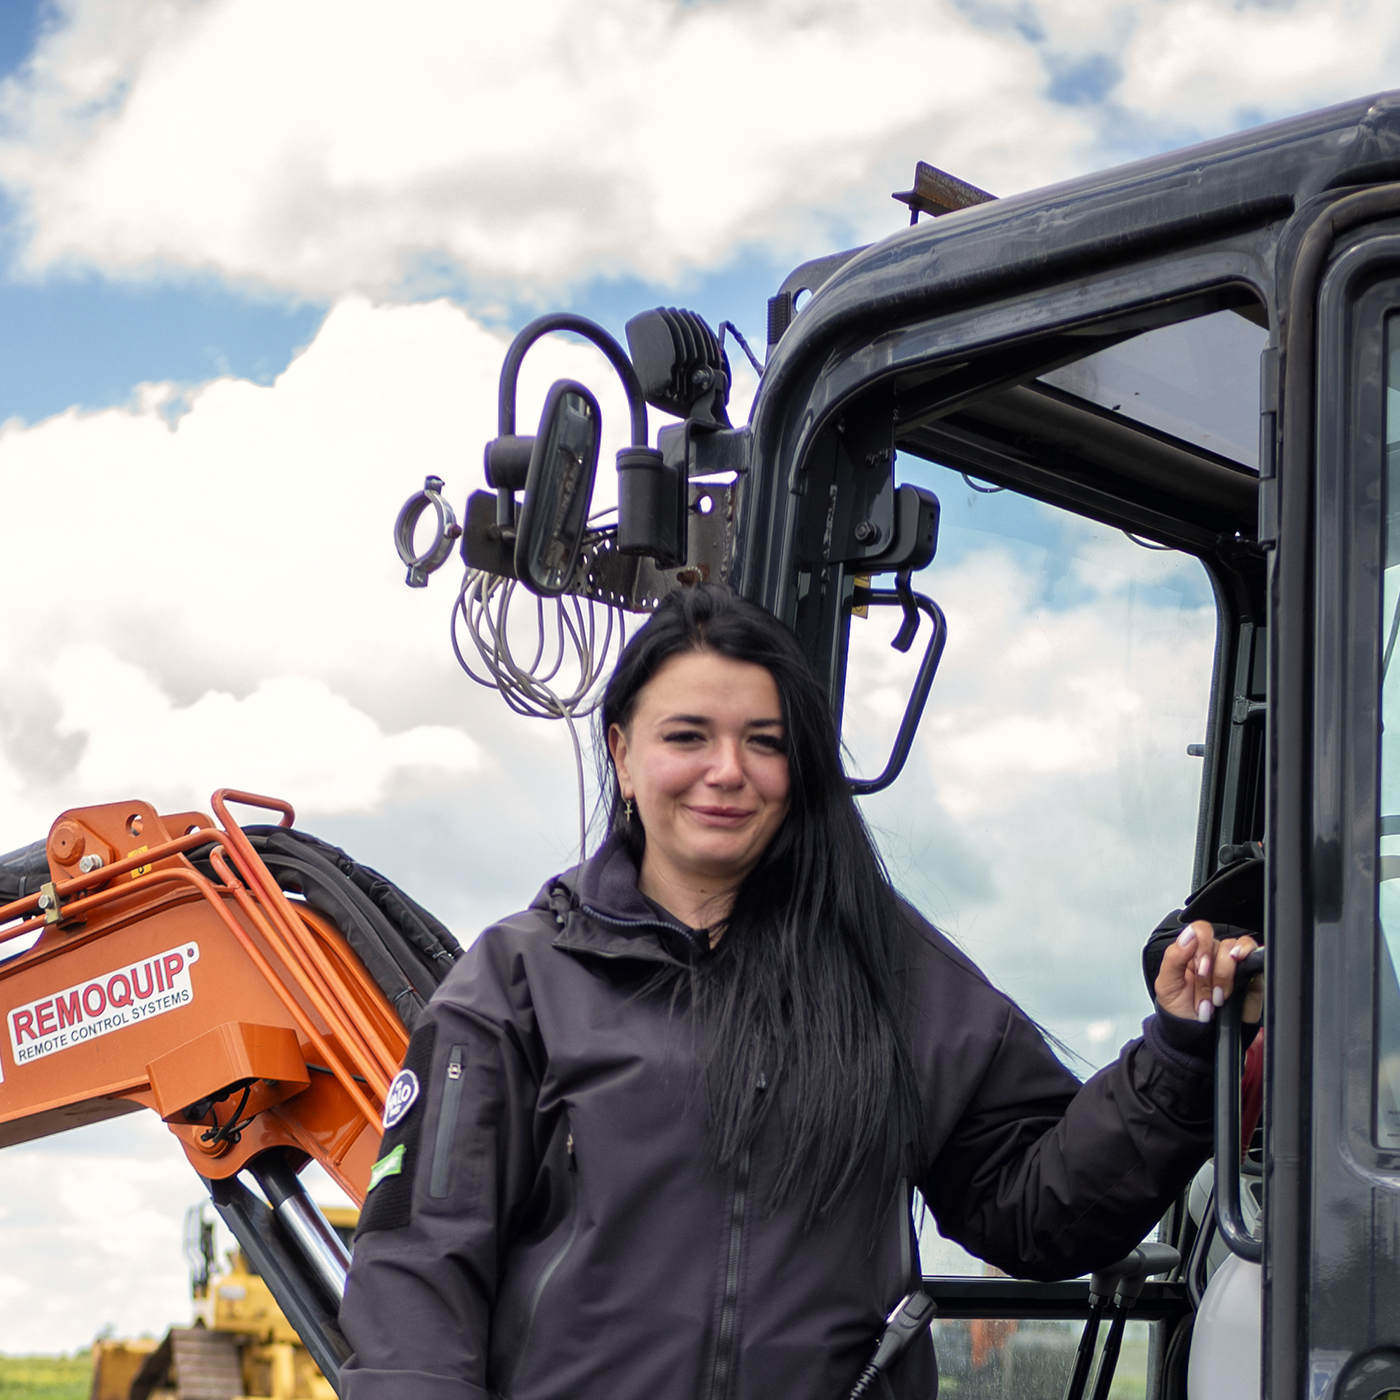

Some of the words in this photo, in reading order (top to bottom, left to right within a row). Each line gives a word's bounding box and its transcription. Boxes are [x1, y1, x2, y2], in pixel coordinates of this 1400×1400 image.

[12, 952, 184, 1046] REMOQUIP
[18, 1034, 68, 1062] REMOTE
[70, 1012, 130, 1042] CONTROL
[132, 989, 190, 1020] SYSTEMS
